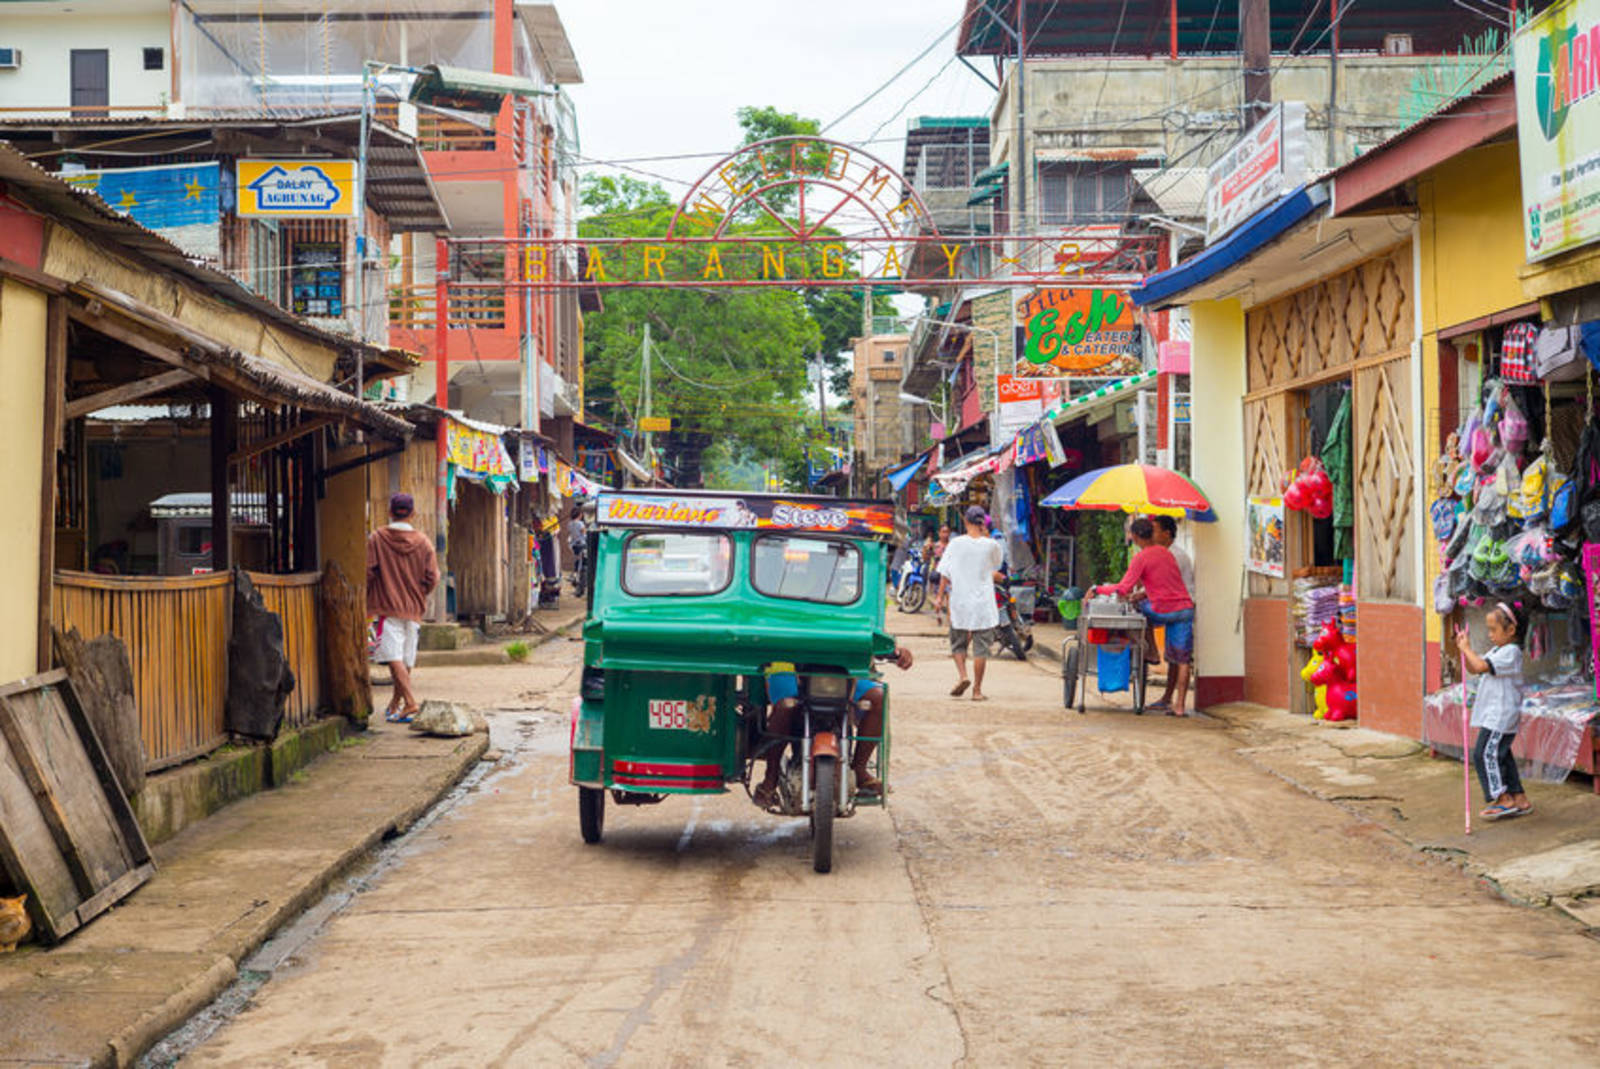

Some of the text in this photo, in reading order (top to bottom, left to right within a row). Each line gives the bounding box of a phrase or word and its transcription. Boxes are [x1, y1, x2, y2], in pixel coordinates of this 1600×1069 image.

[679, 141, 922, 231] WELCOME
[525, 244, 961, 280] BARANGAY
[1085, 330, 1139, 343] EATERY
[771, 505, 849, 528] Steve
[650, 701, 686, 729] 496
